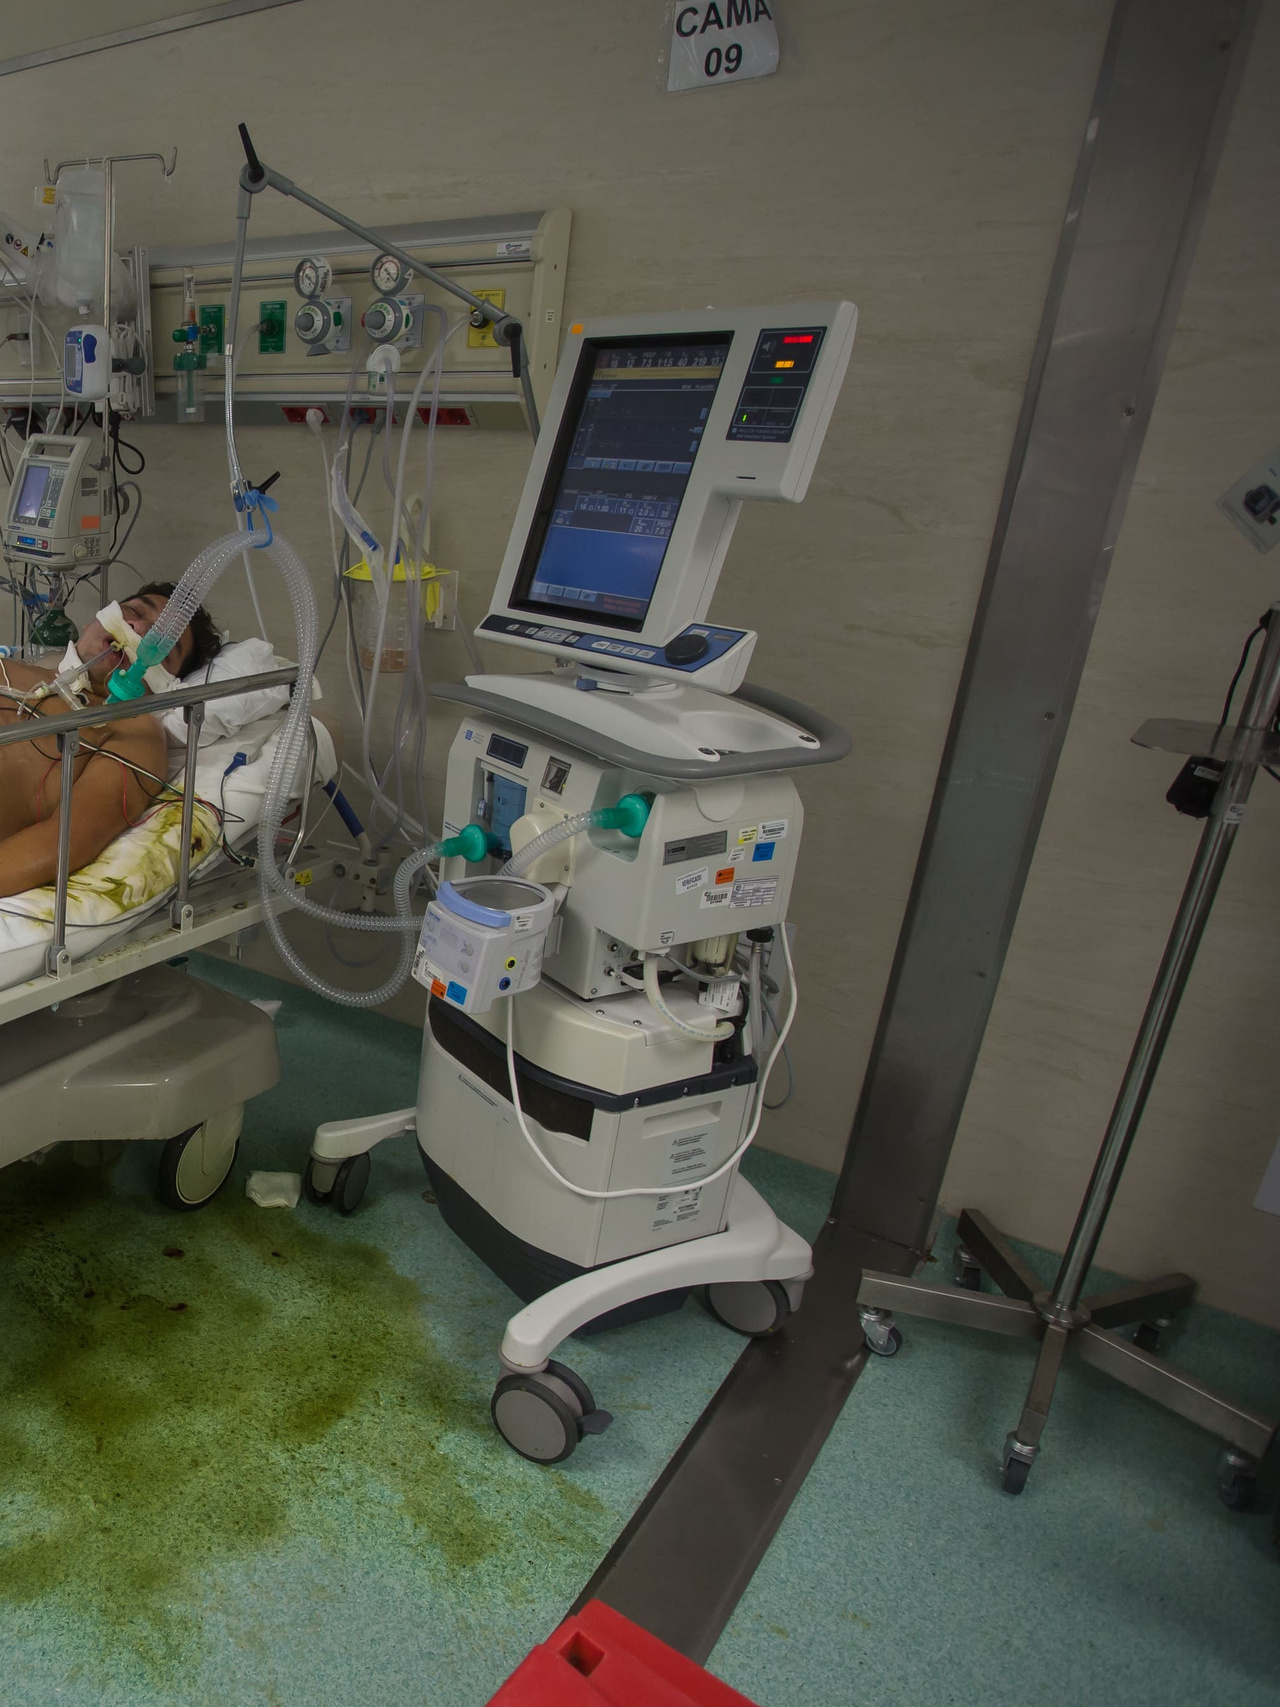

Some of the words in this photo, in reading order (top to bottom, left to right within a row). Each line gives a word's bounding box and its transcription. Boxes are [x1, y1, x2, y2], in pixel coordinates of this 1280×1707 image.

[676, 0, 772, 37] CAMA
[704, 43, 742, 77] 09
[677, 358, 688, 366] 40
